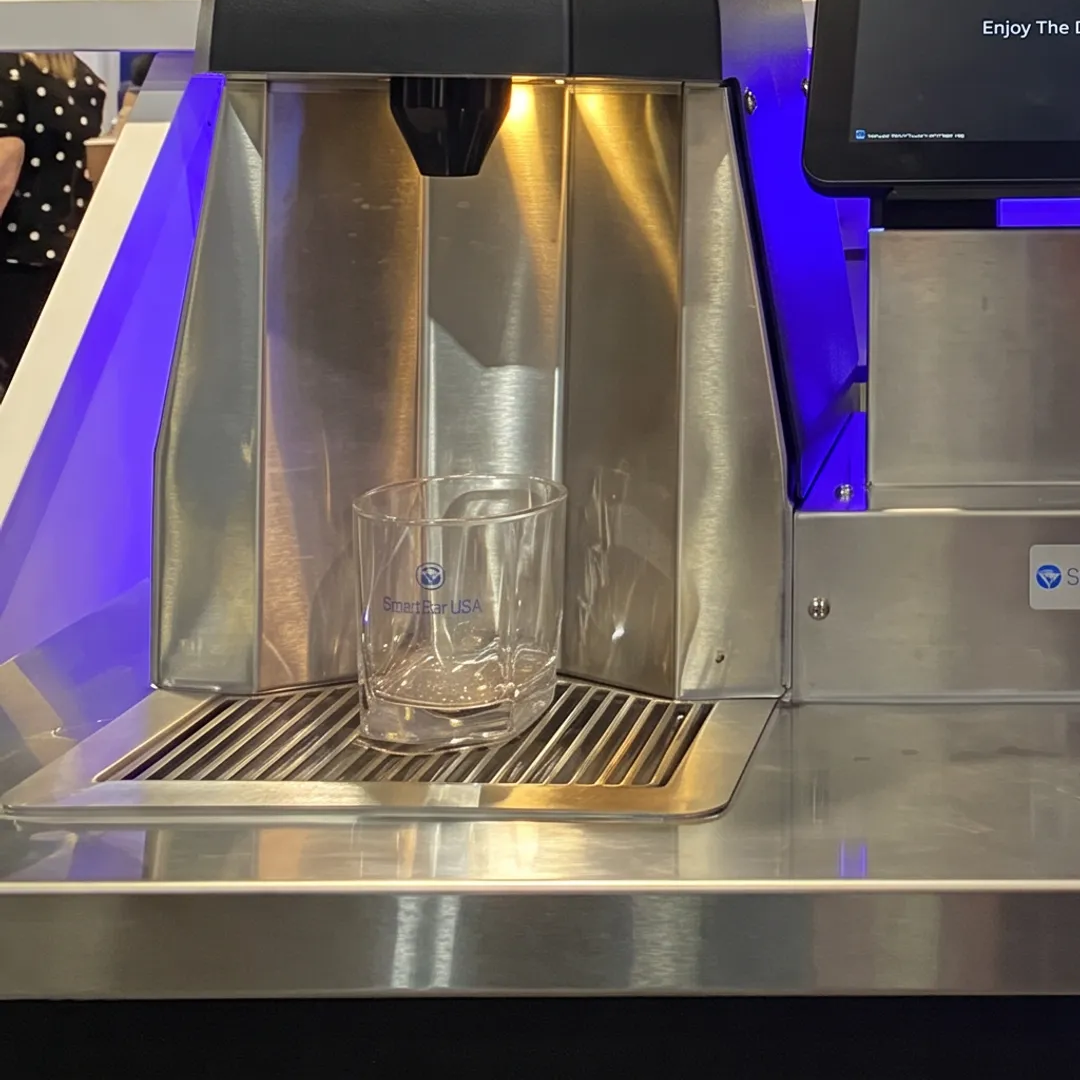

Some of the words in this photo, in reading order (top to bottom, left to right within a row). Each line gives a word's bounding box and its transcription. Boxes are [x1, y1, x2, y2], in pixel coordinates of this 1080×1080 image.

[982, 20, 1031, 38] Enjoy
[1036, 20, 1070, 35] The
[383, 597, 421, 614] Smart
[450, 598, 483, 614] USA
